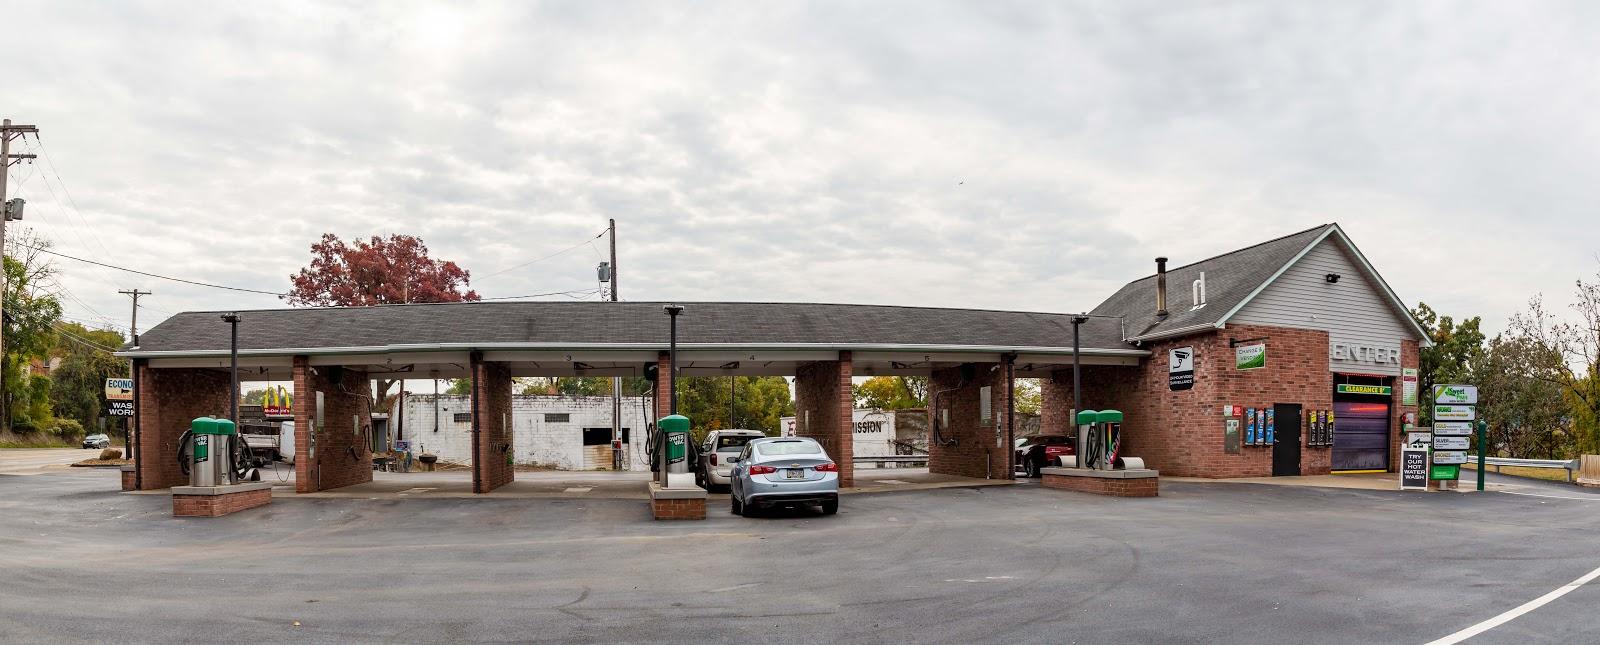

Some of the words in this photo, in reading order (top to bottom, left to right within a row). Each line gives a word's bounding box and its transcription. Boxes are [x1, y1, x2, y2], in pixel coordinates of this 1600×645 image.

[1333, 343, 1399, 363] ENTER
[108, 379, 133, 389] ECONO
[852, 421, 882, 433] ISSION
